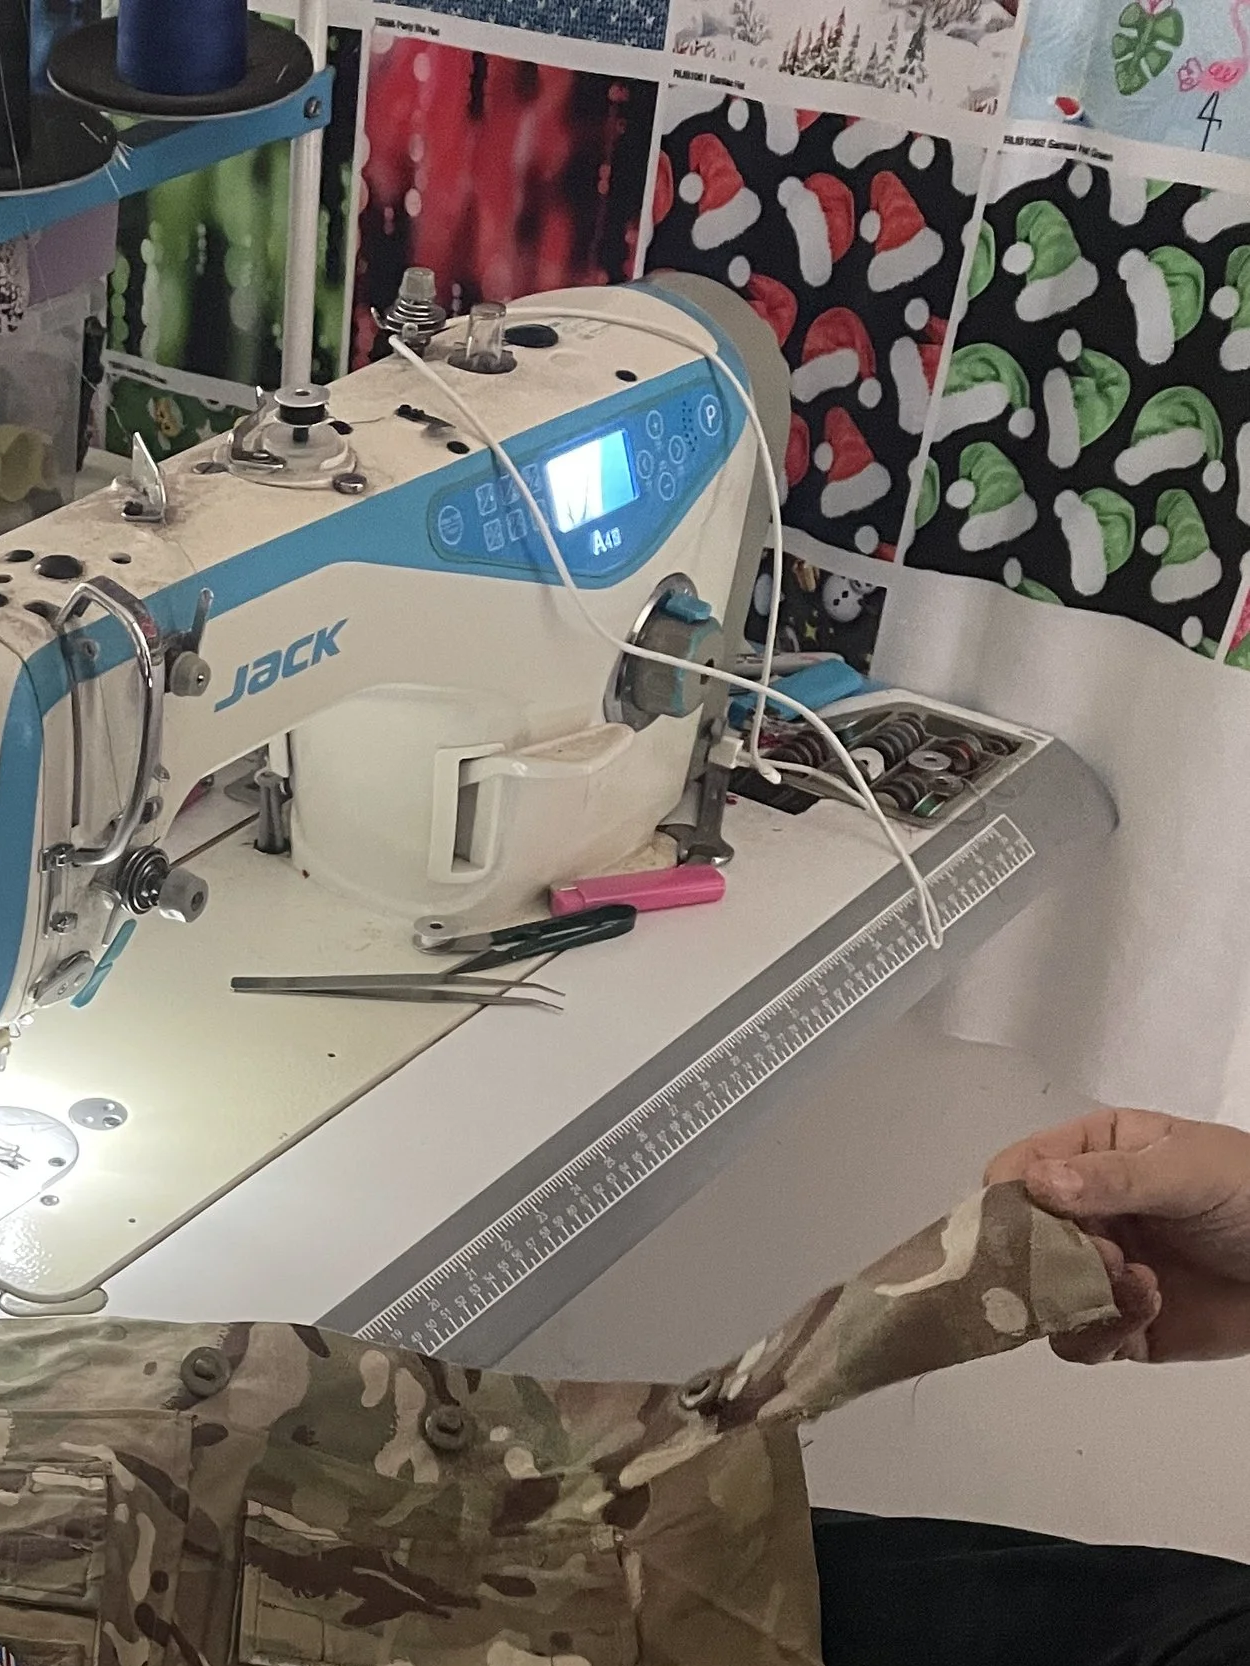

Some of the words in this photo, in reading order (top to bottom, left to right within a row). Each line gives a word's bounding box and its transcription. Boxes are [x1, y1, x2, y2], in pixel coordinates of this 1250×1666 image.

[705, 404, 716, 428] P
[428, 1298, 441, 1311] 20
[465, 1268, 478, 1282] 21
[501, 1239, 514, 1252] 22
[425, 1318, 438, 1332] 50
[439, 1307, 452, 1321] 51
